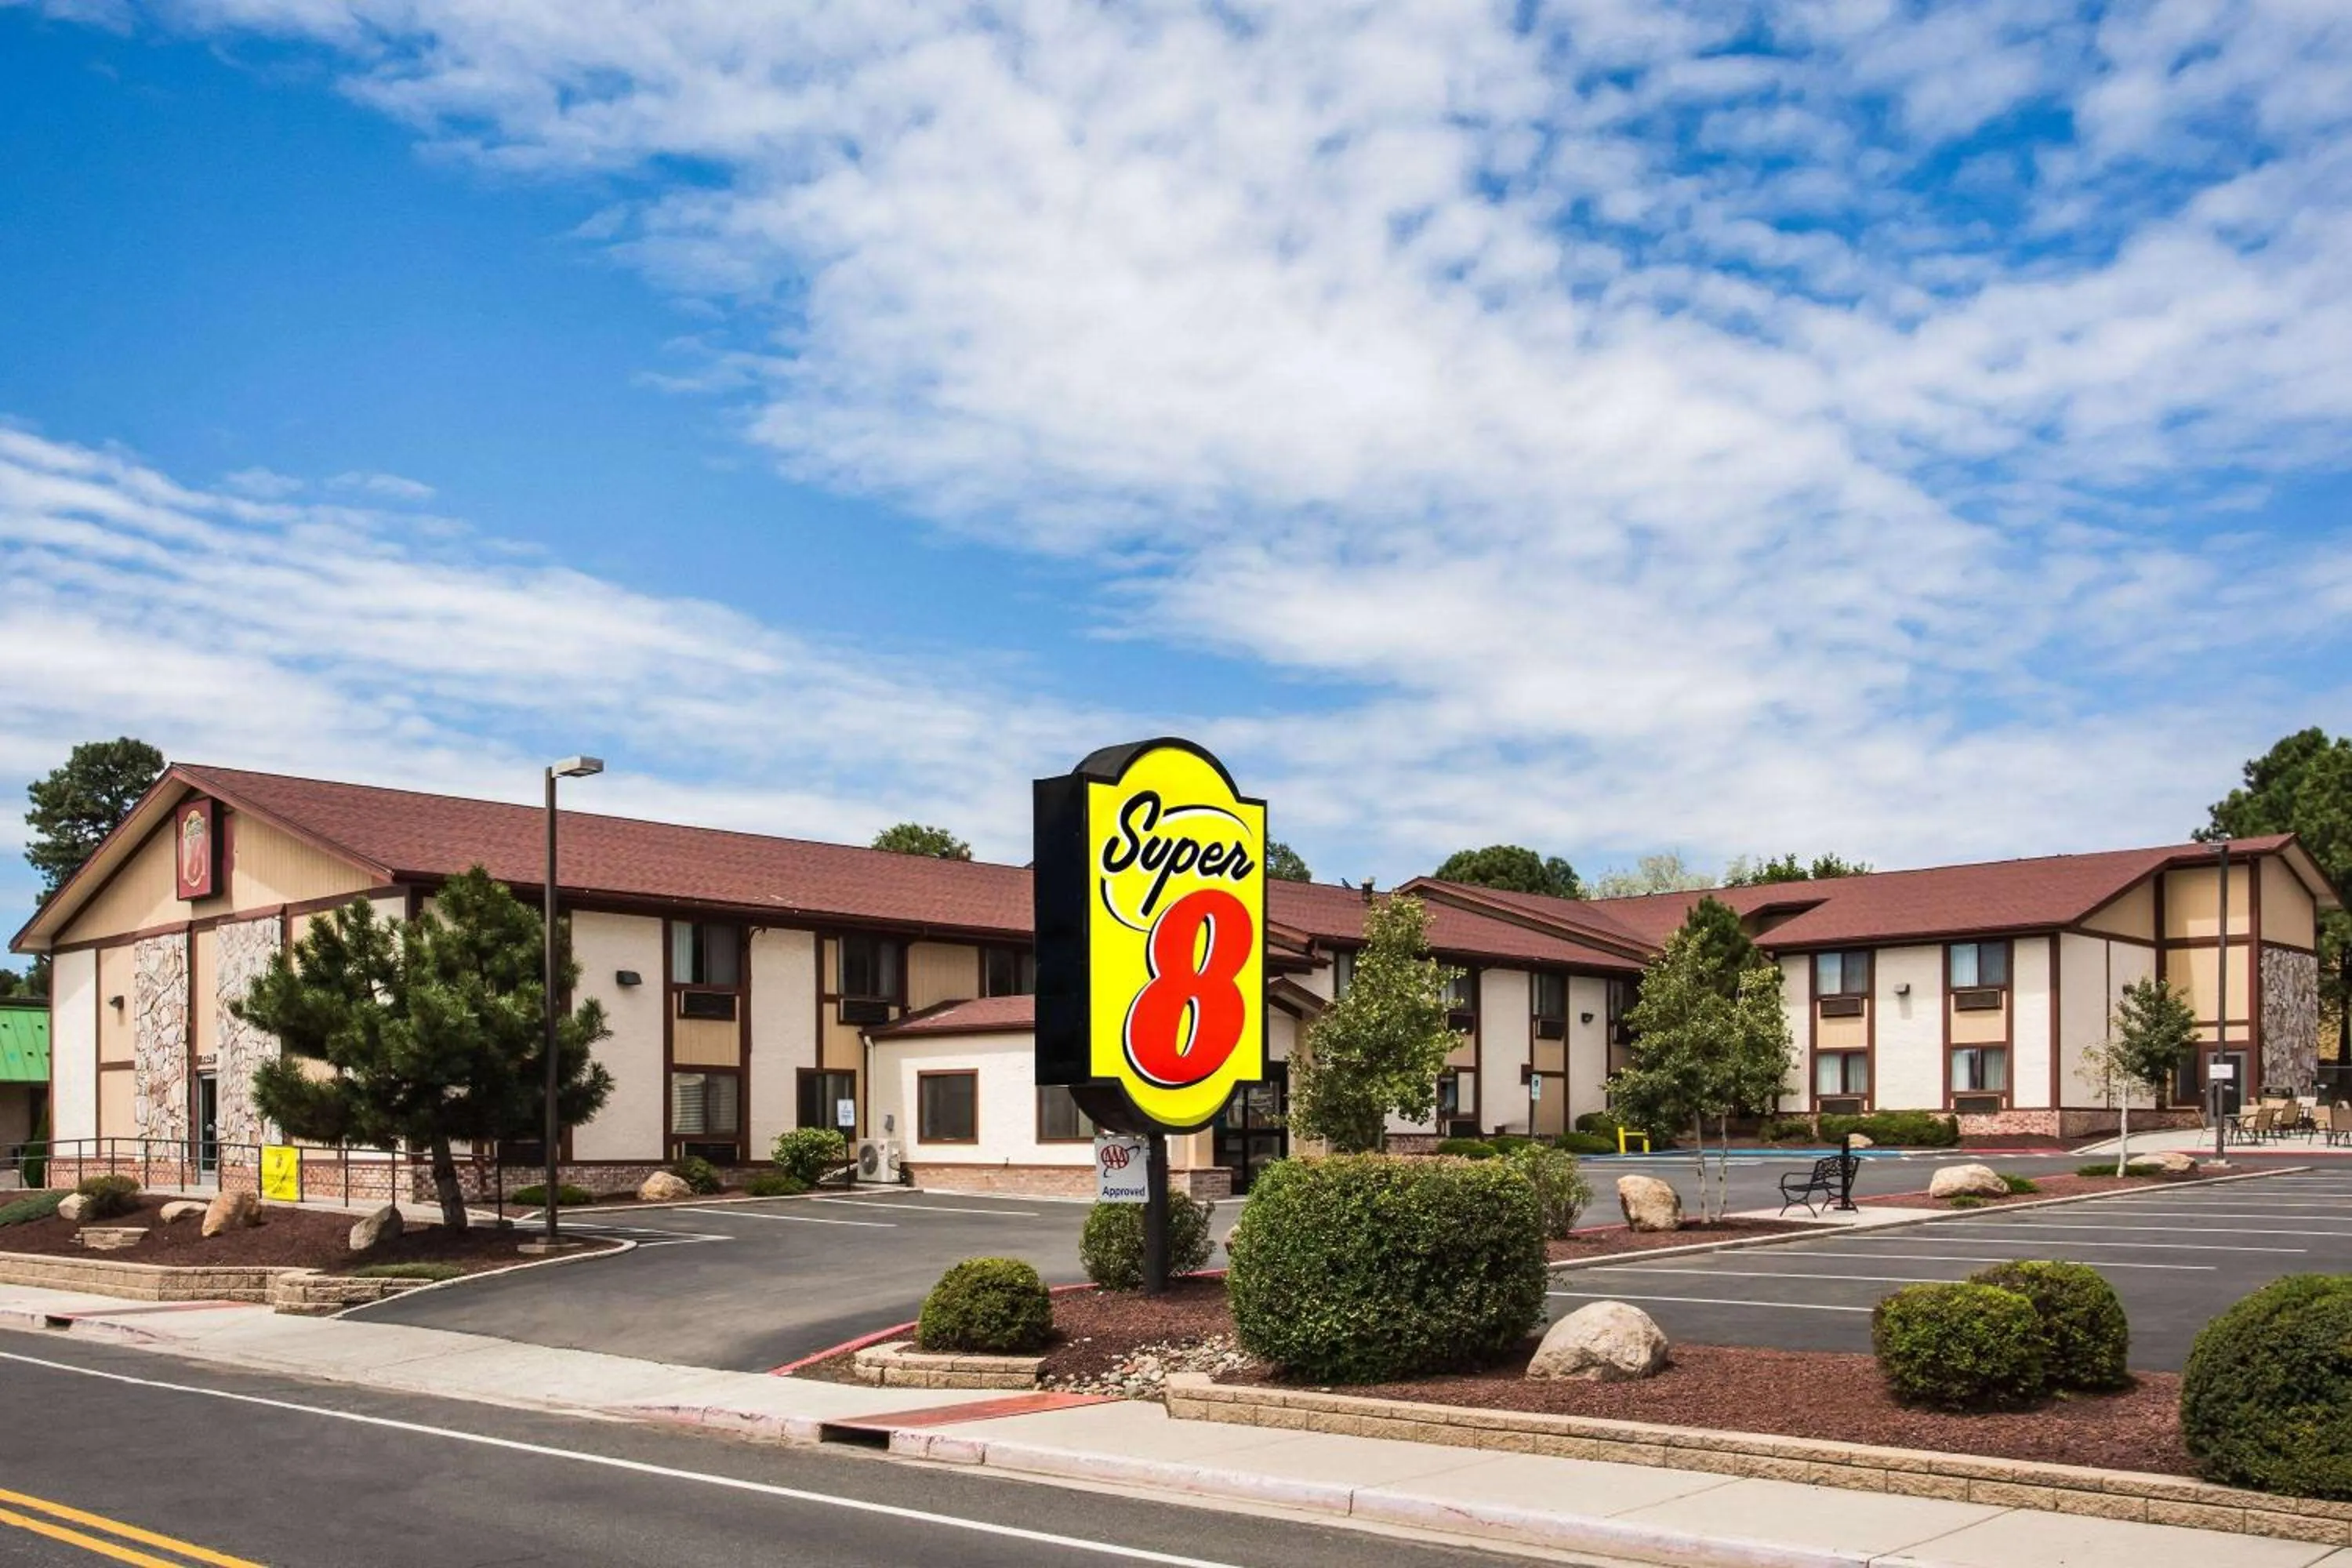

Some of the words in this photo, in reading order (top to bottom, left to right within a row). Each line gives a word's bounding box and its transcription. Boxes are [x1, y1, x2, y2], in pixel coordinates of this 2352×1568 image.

[1102, 790, 1255, 916] Super
[1123, 888, 1254, 1089] 8
[1102, 1186, 1145, 1198] Approved
